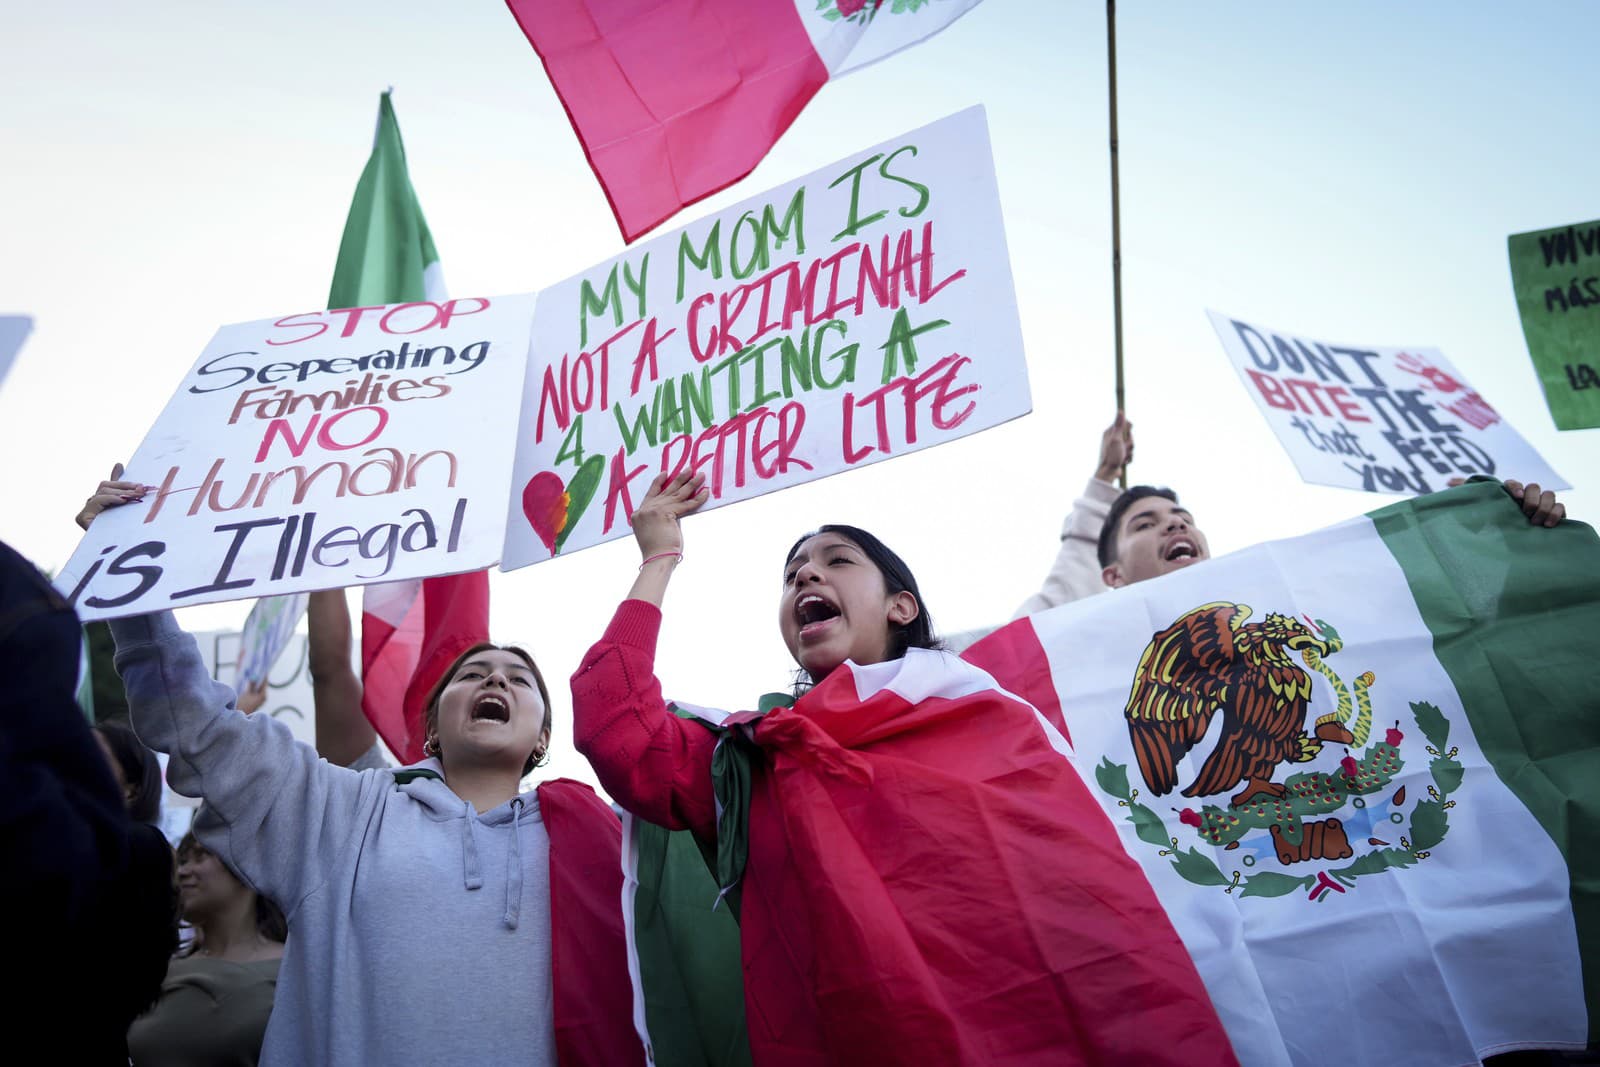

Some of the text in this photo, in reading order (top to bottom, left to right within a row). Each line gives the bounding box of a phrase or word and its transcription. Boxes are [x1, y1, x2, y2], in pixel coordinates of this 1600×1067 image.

[580, 145, 930, 351] MY MOM IS
[265, 297, 491, 346] STOP
[535, 220, 967, 445] NOT A CRIMINAL
[188, 341, 491, 394] Seperating
[227, 372, 452, 425] Families
[554, 305, 951, 466] 4 WANTING A
[1243, 367, 1464, 433] BITE THE
[254, 405, 389, 463] NO
[1381, 431, 1496, 475] FEED
[143, 447, 458, 524] Human
[602, 445, 648, 535] A
[170, 497, 468, 600] Illegal
